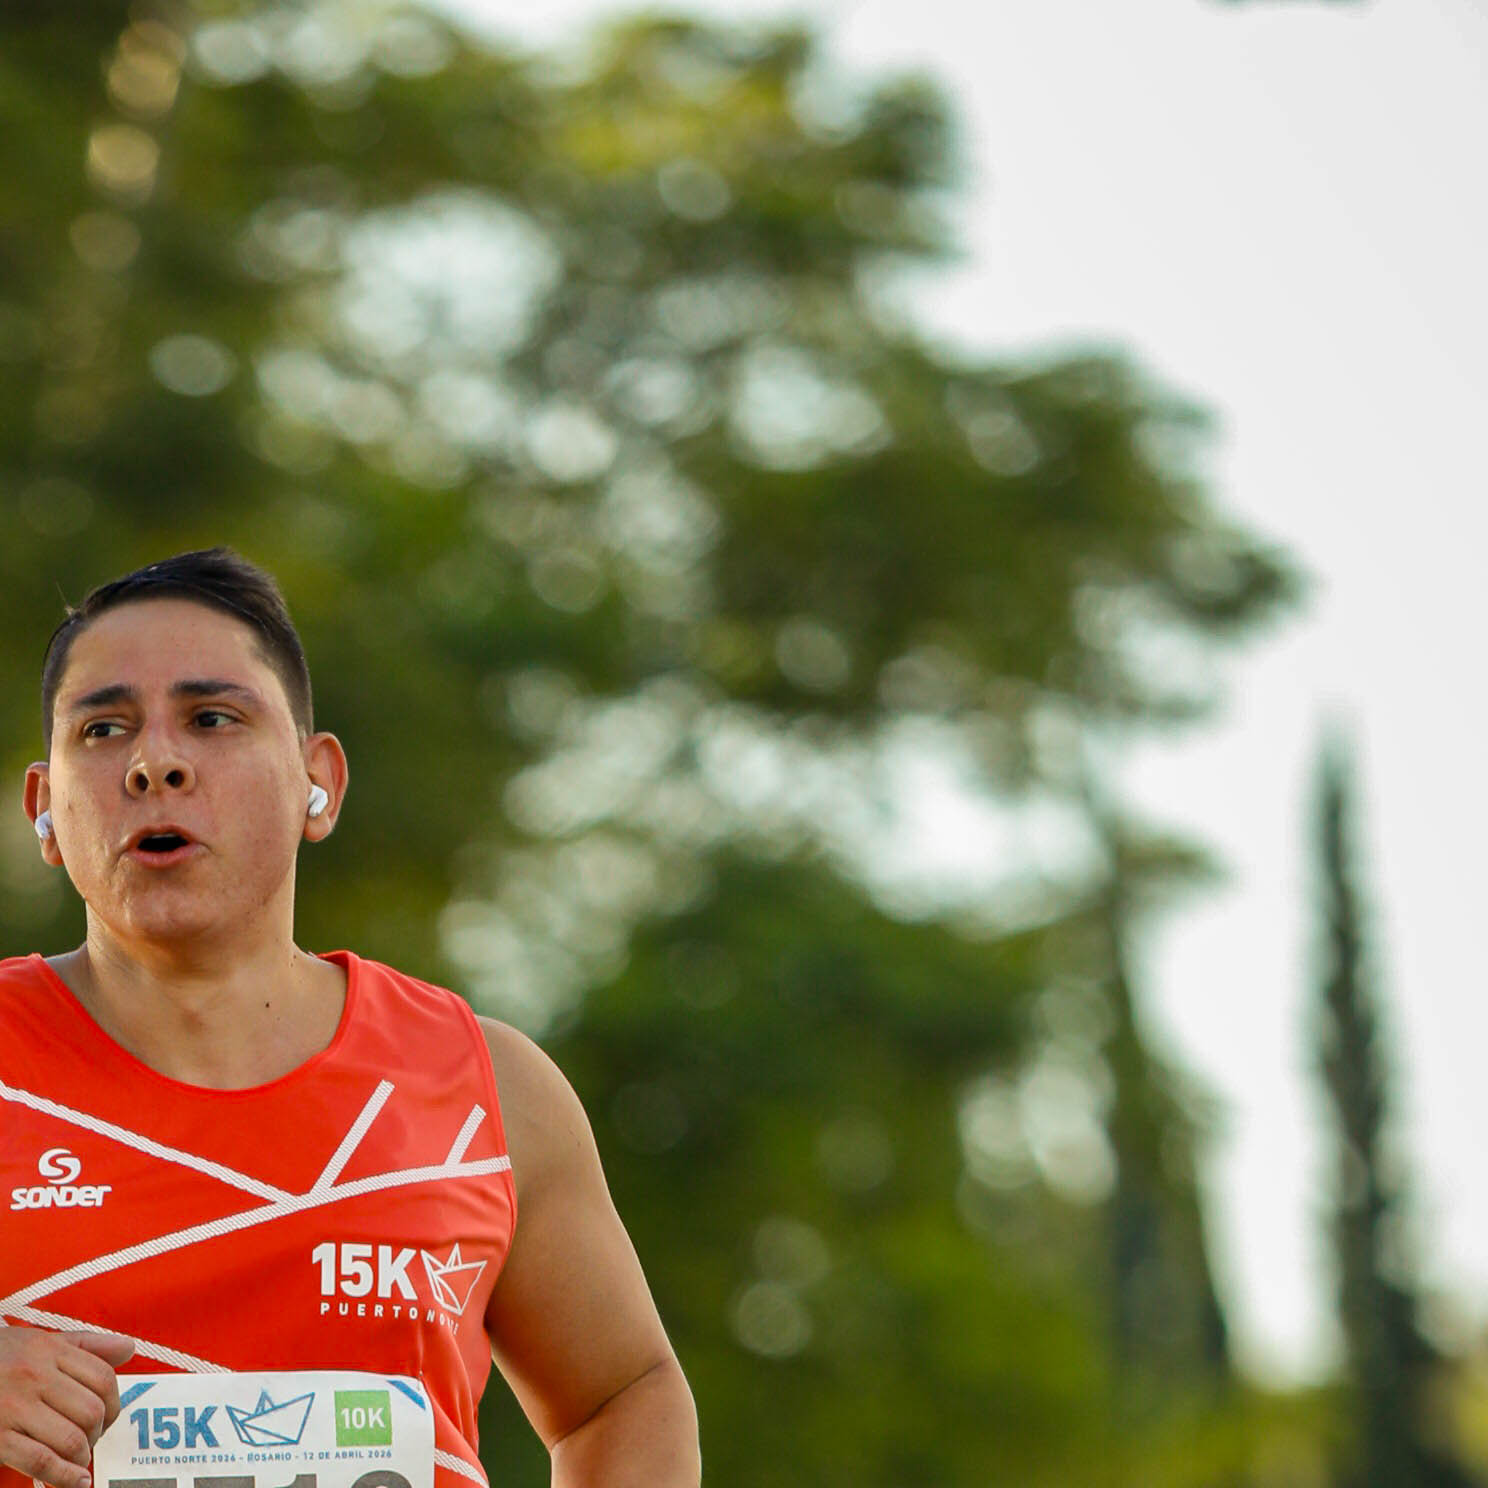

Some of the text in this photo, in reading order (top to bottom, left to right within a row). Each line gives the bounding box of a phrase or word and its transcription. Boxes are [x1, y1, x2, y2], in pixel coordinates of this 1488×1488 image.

[312, 1242, 418, 1300] 15K
[320, 1303, 418, 1320] PUERTO
[129, 1406, 220, 1450] 15K
[340, 1407, 385, 1430] 10K
[131, 1455, 171, 1465] PUERTO
[174, 1455, 208, 1464] NORTE
[247, 1452, 292, 1462] ROSARIO
[303, 1451, 314, 1461] 12
[318, 1451, 331, 1460] DE
[335, 1450, 364, 1460] ABRIL
[368, 1449, 392, 1459] 2026
